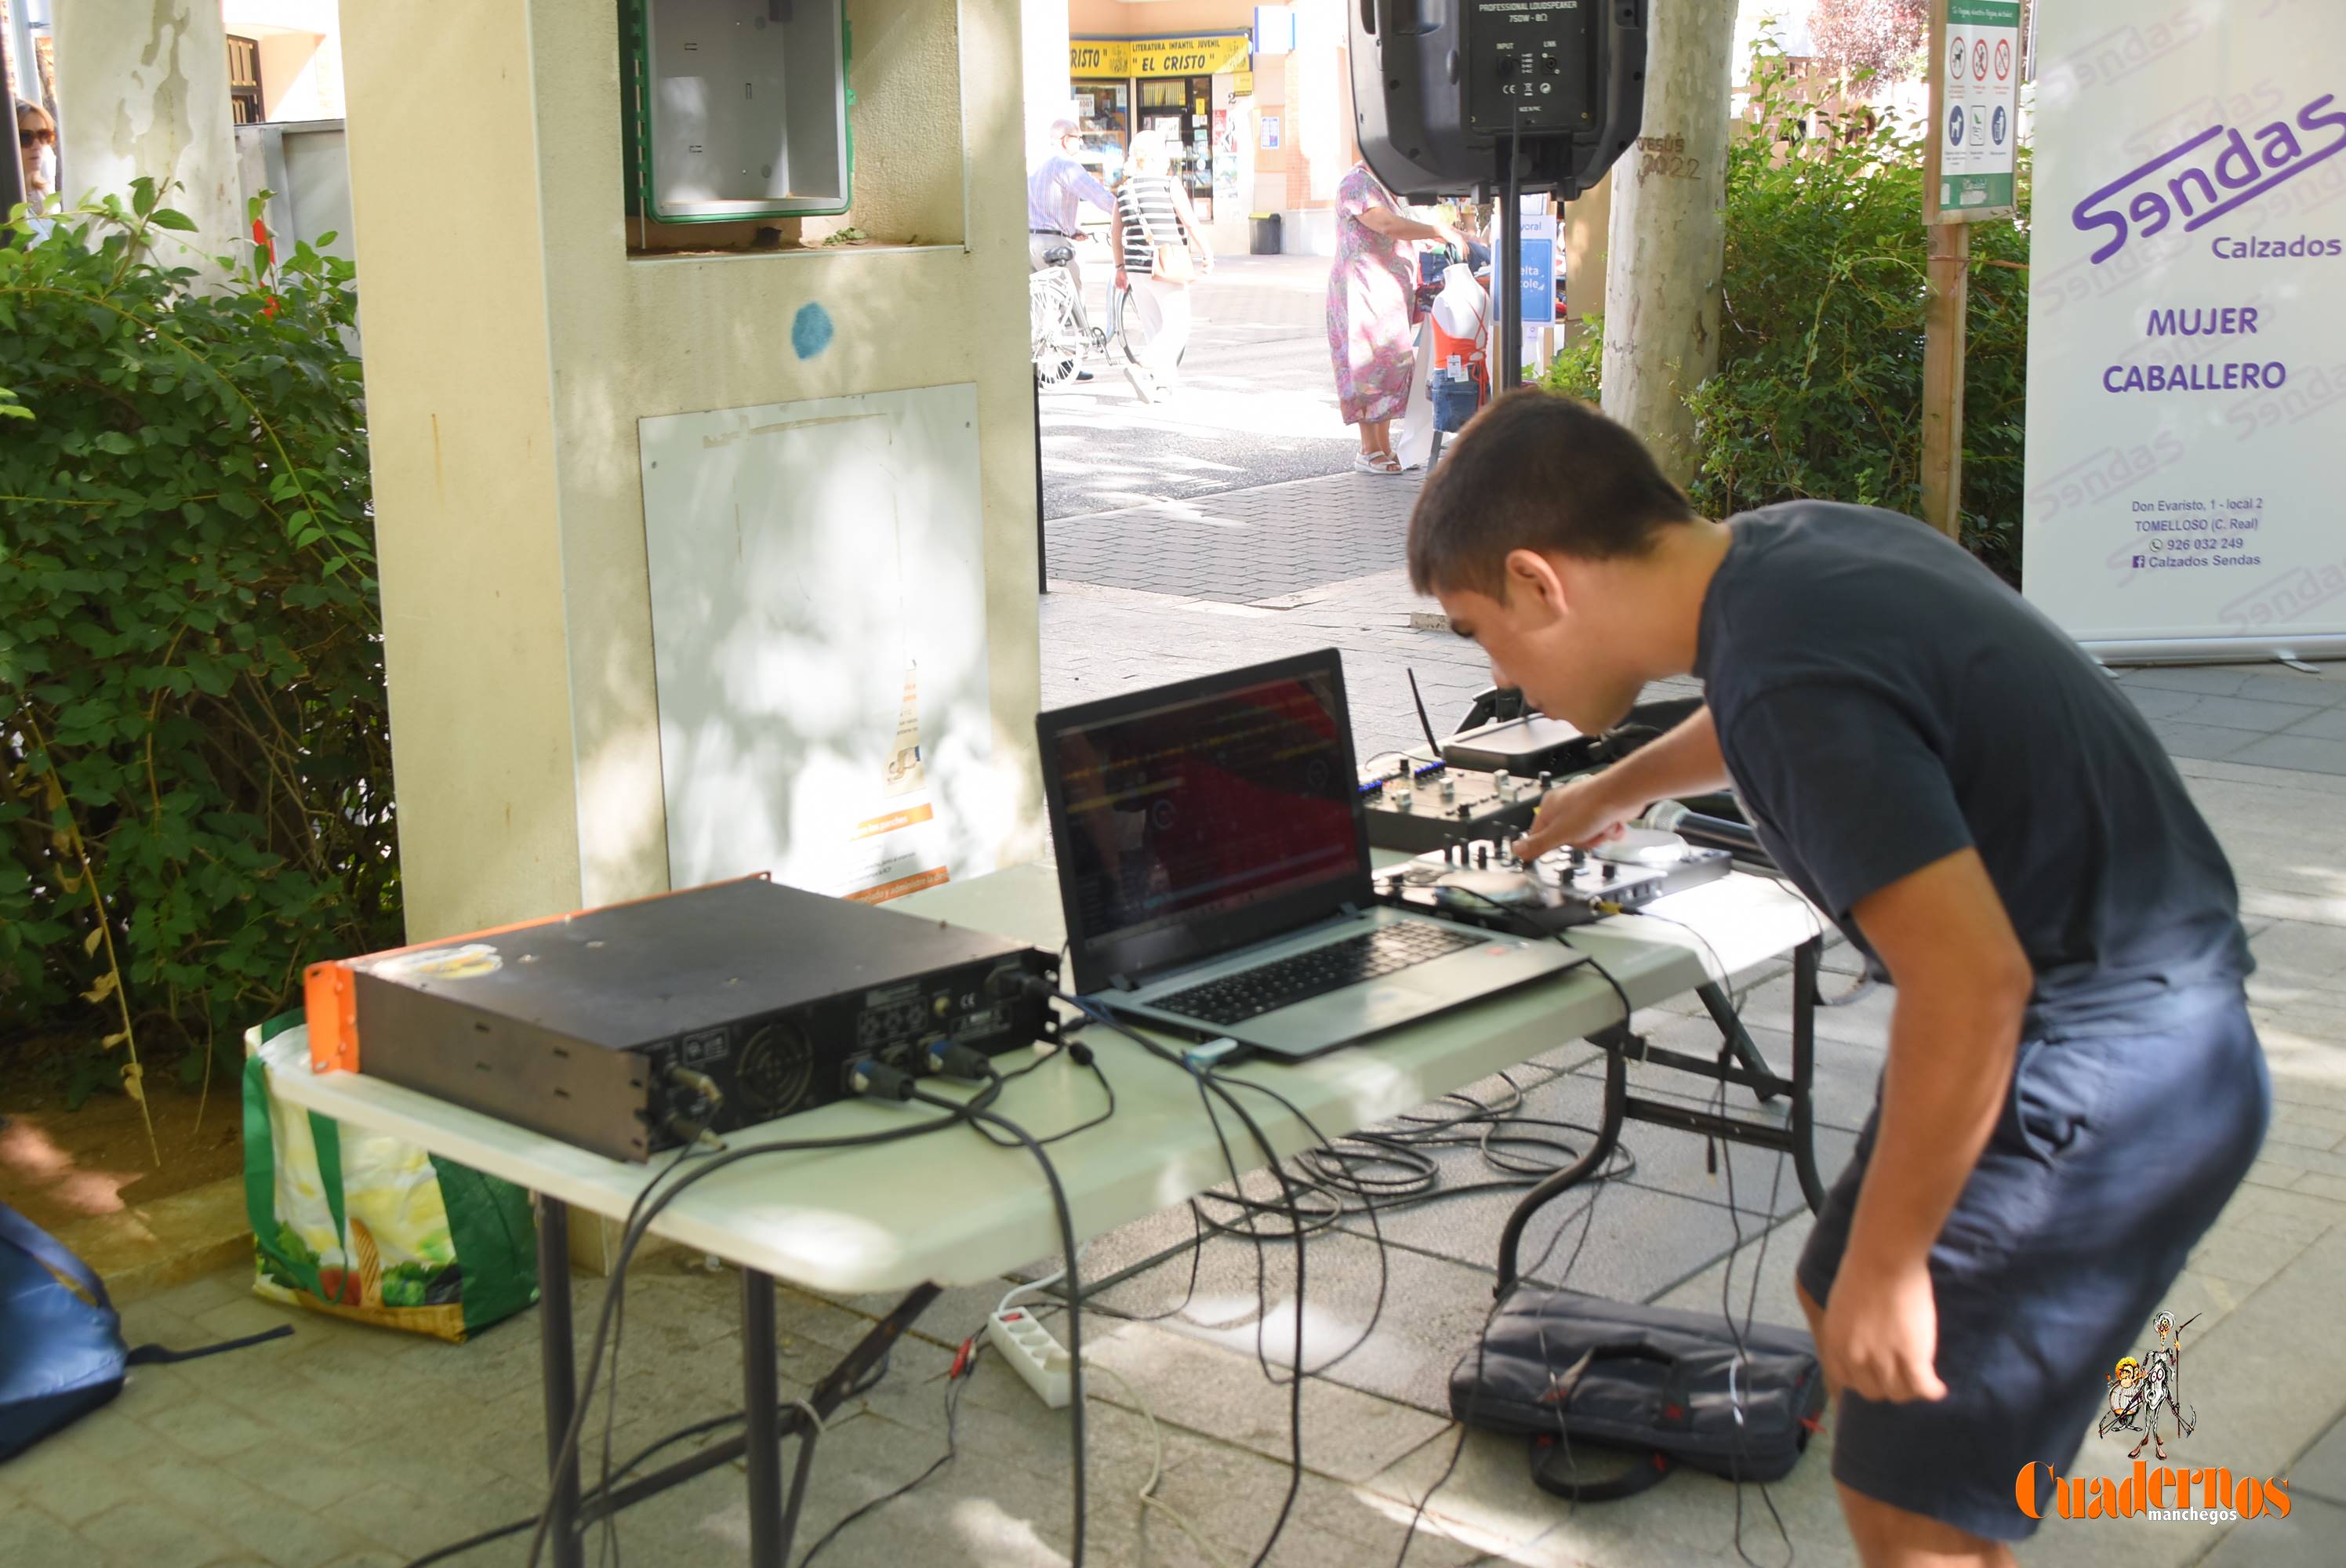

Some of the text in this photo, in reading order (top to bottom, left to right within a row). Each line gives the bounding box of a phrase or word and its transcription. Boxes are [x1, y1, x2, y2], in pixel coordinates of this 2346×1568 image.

[1530, 1, 1578, 9] LOUDSPEAKER
[1132, 38, 1220, 52] LITERATURA INFANTIL JUVENIL
[1142, 57, 1154, 72] EL
[1164, 54, 1206, 71] CRISTO
[2072, 93, 2346, 265] Sendas
[2211, 234, 2343, 260] Calzados
[2146, 307, 2259, 336] MUJER
[2102, 361, 2286, 394] CABALLERO
[2132, 501, 2154, 512] Don
[2158, 499, 2206, 512] Evaristo,
[2211, 499, 2216, 510] 1
[2227, 498, 2253, 510] local
[2256, 498, 2263, 509] 2
[2135, 517, 2258, 532] TOMELLOSO (C. Real)
[2166, 538, 2243, 550] 926 032 249
[2148, 554, 2261, 568] Calzados Sendas
